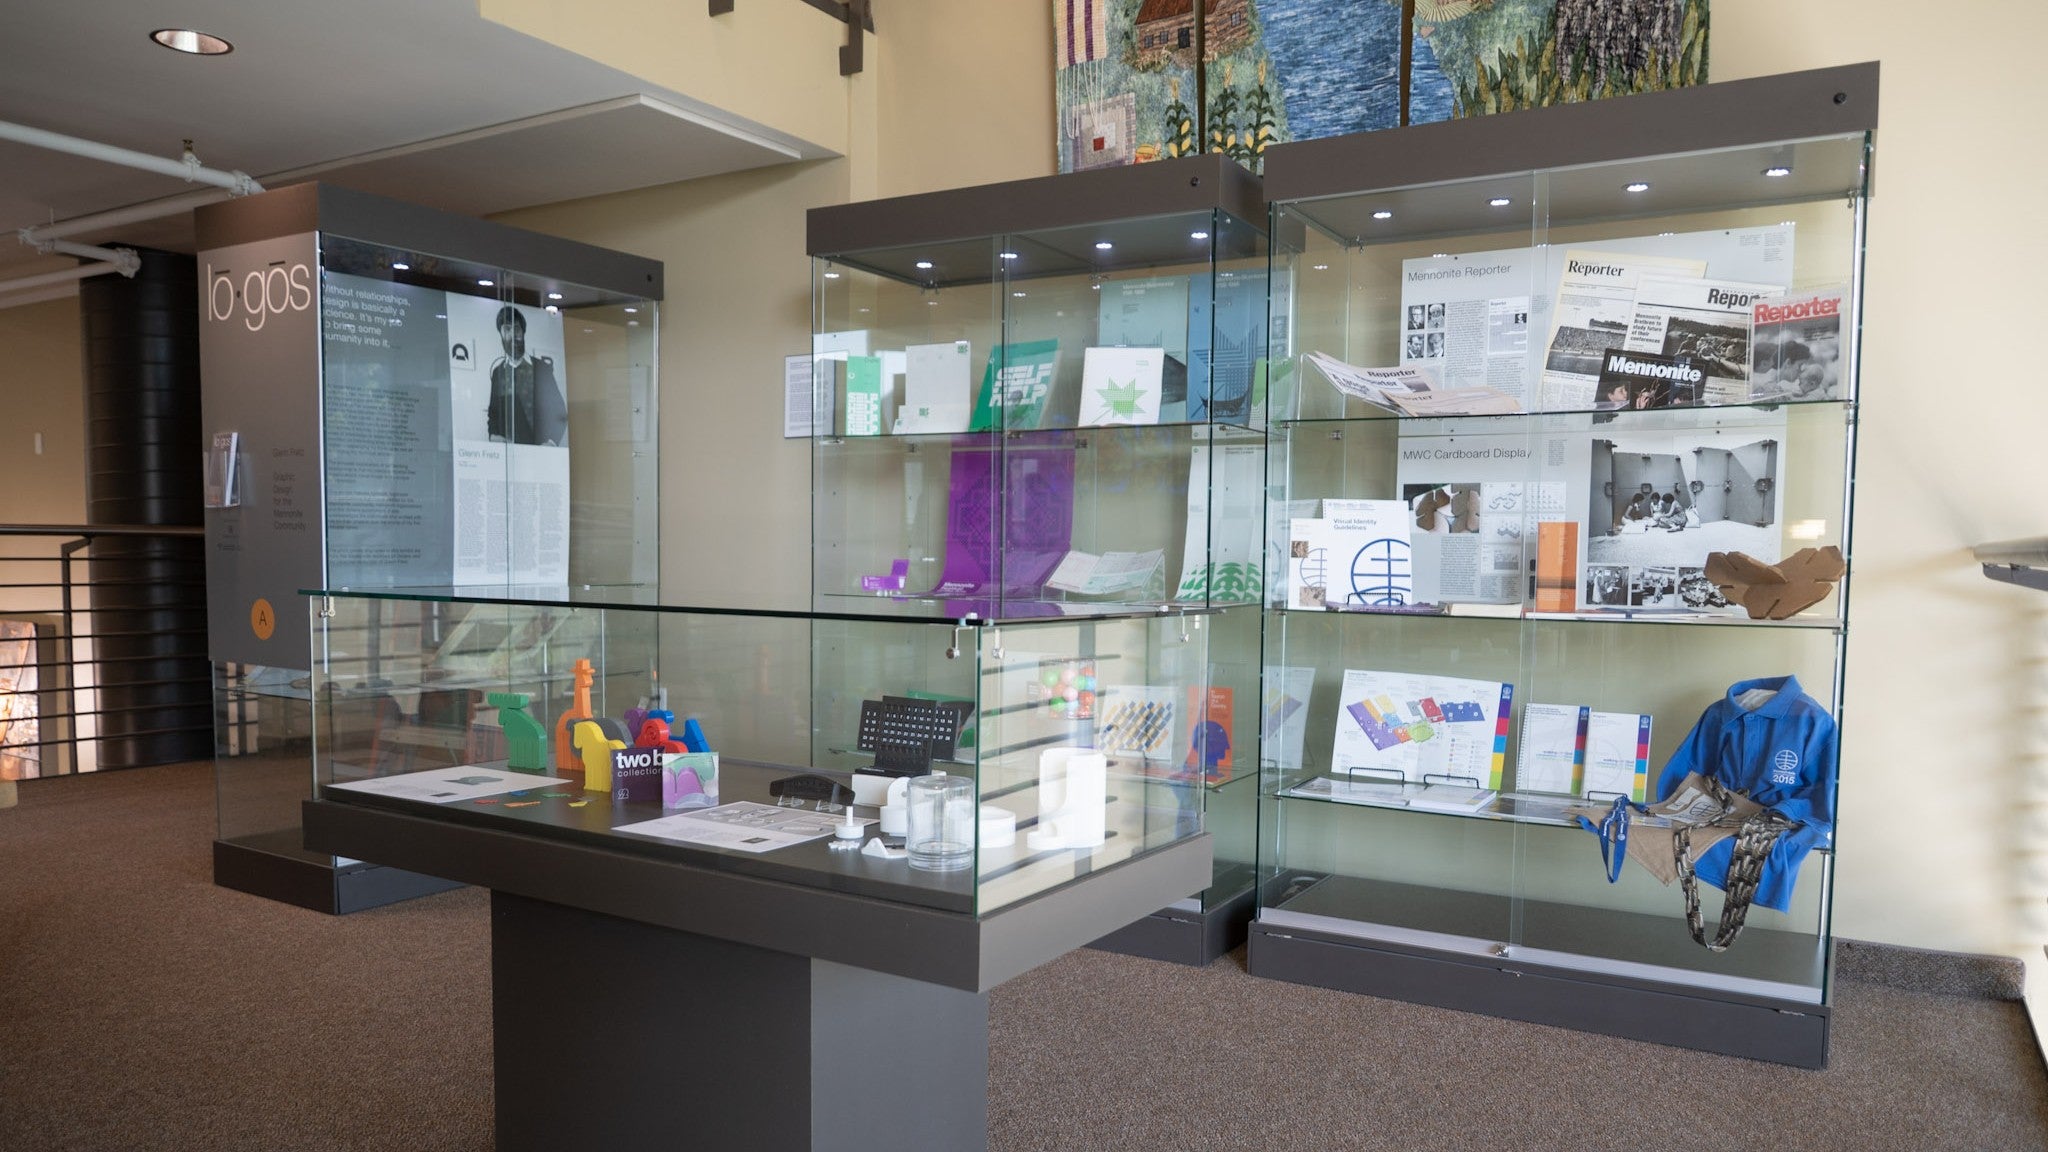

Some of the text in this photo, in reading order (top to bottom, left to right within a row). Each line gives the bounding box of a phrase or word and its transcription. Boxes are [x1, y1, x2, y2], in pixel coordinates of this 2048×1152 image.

[1408, 264, 1512, 282] Mennonite Reporter
[1568, 260, 1624, 277] Reporter
[324, 284, 410, 307] ithout relationships,
[352, 300, 359, 310] is
[362, 301, 398, 316] basically
[400, 308, 406, 316] a
[1754, 297, 1841, 323] Reporter
[334, 321, 356, 334] bring
[358, 325, 382, 336] some
[374, 316, 387, 326] my
[364, 337, 380, 347] into
[996, 362, 1053, 385] SELF
[1367, 369, 1416, 379] Reporter
[1608, 355, 1702, 382] Mennonite
[989, 384, 1048, 407] HELP
[1403, 448, 1532, 460] MWC Cardboard Display
[258, 610, 267, 626] A
[616, 752, 652, 769] two
[1773, 774, 1795, 784] 2015
